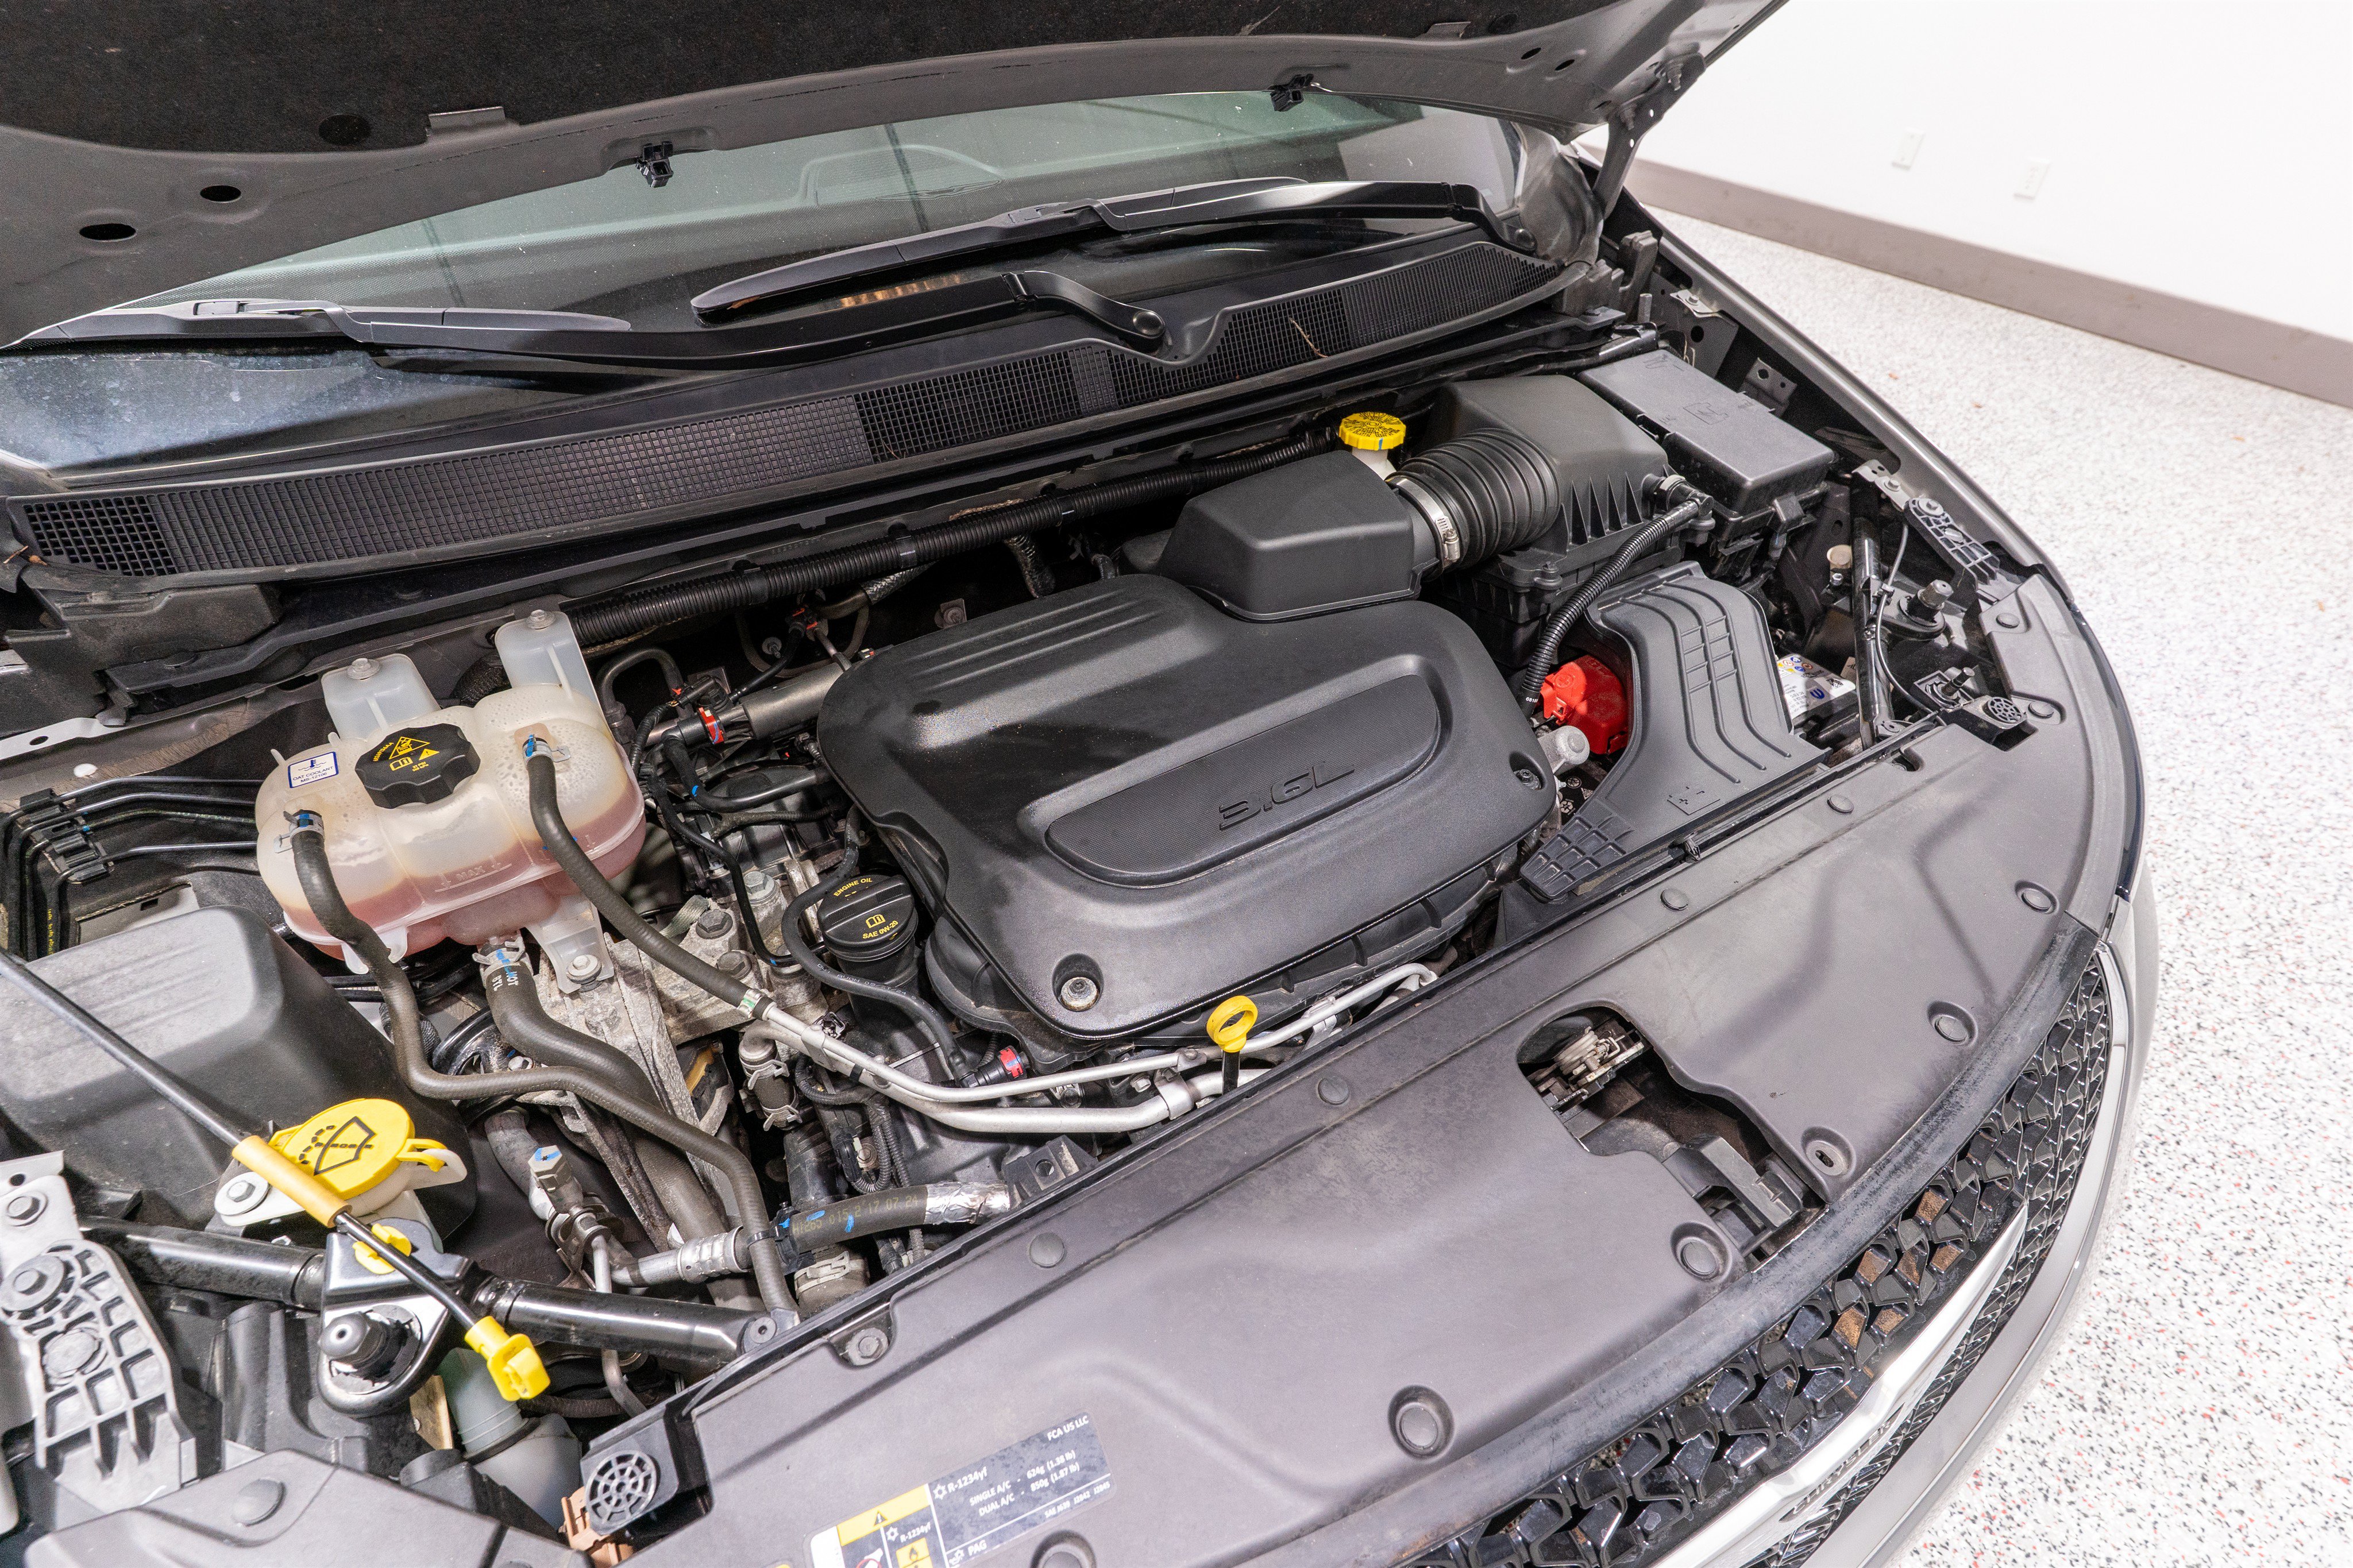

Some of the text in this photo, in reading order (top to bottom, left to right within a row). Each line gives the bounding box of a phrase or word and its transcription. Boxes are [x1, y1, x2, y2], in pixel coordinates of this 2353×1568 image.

[300, 772, 327, 782] MS-12106
[306, 766, 333, 777] COOLANT
[1218, 761, 1355, 831] 3.6L
[456, 866, 486, 882] MAX
[834, 879, 859, 897] ENGINE
[862, 920, 899, 940] SAE 0W-20
[492, 974, 503, 992] BTL
[1047, 1415, 1089, 1441] FCA US LLC
[947, 1466, 988, 1493] R-1234yf
[969, 1487, 997, 1506] SINGLE
[997, 1480, 1011, 1494] A/C
[1064, 1450, 1076, 1461] lb)
[978, 1500, 1001, 1516] DUAL
[1000, 1492, 1015, 1506] A/C
[1069, 1462, 1080, 1474] lb)
[1044, 1508, 1056, 1519] SAE
[900, 1521, 931, 1544] R-1234yf
[967, 1539, 988, 1556] PAG
